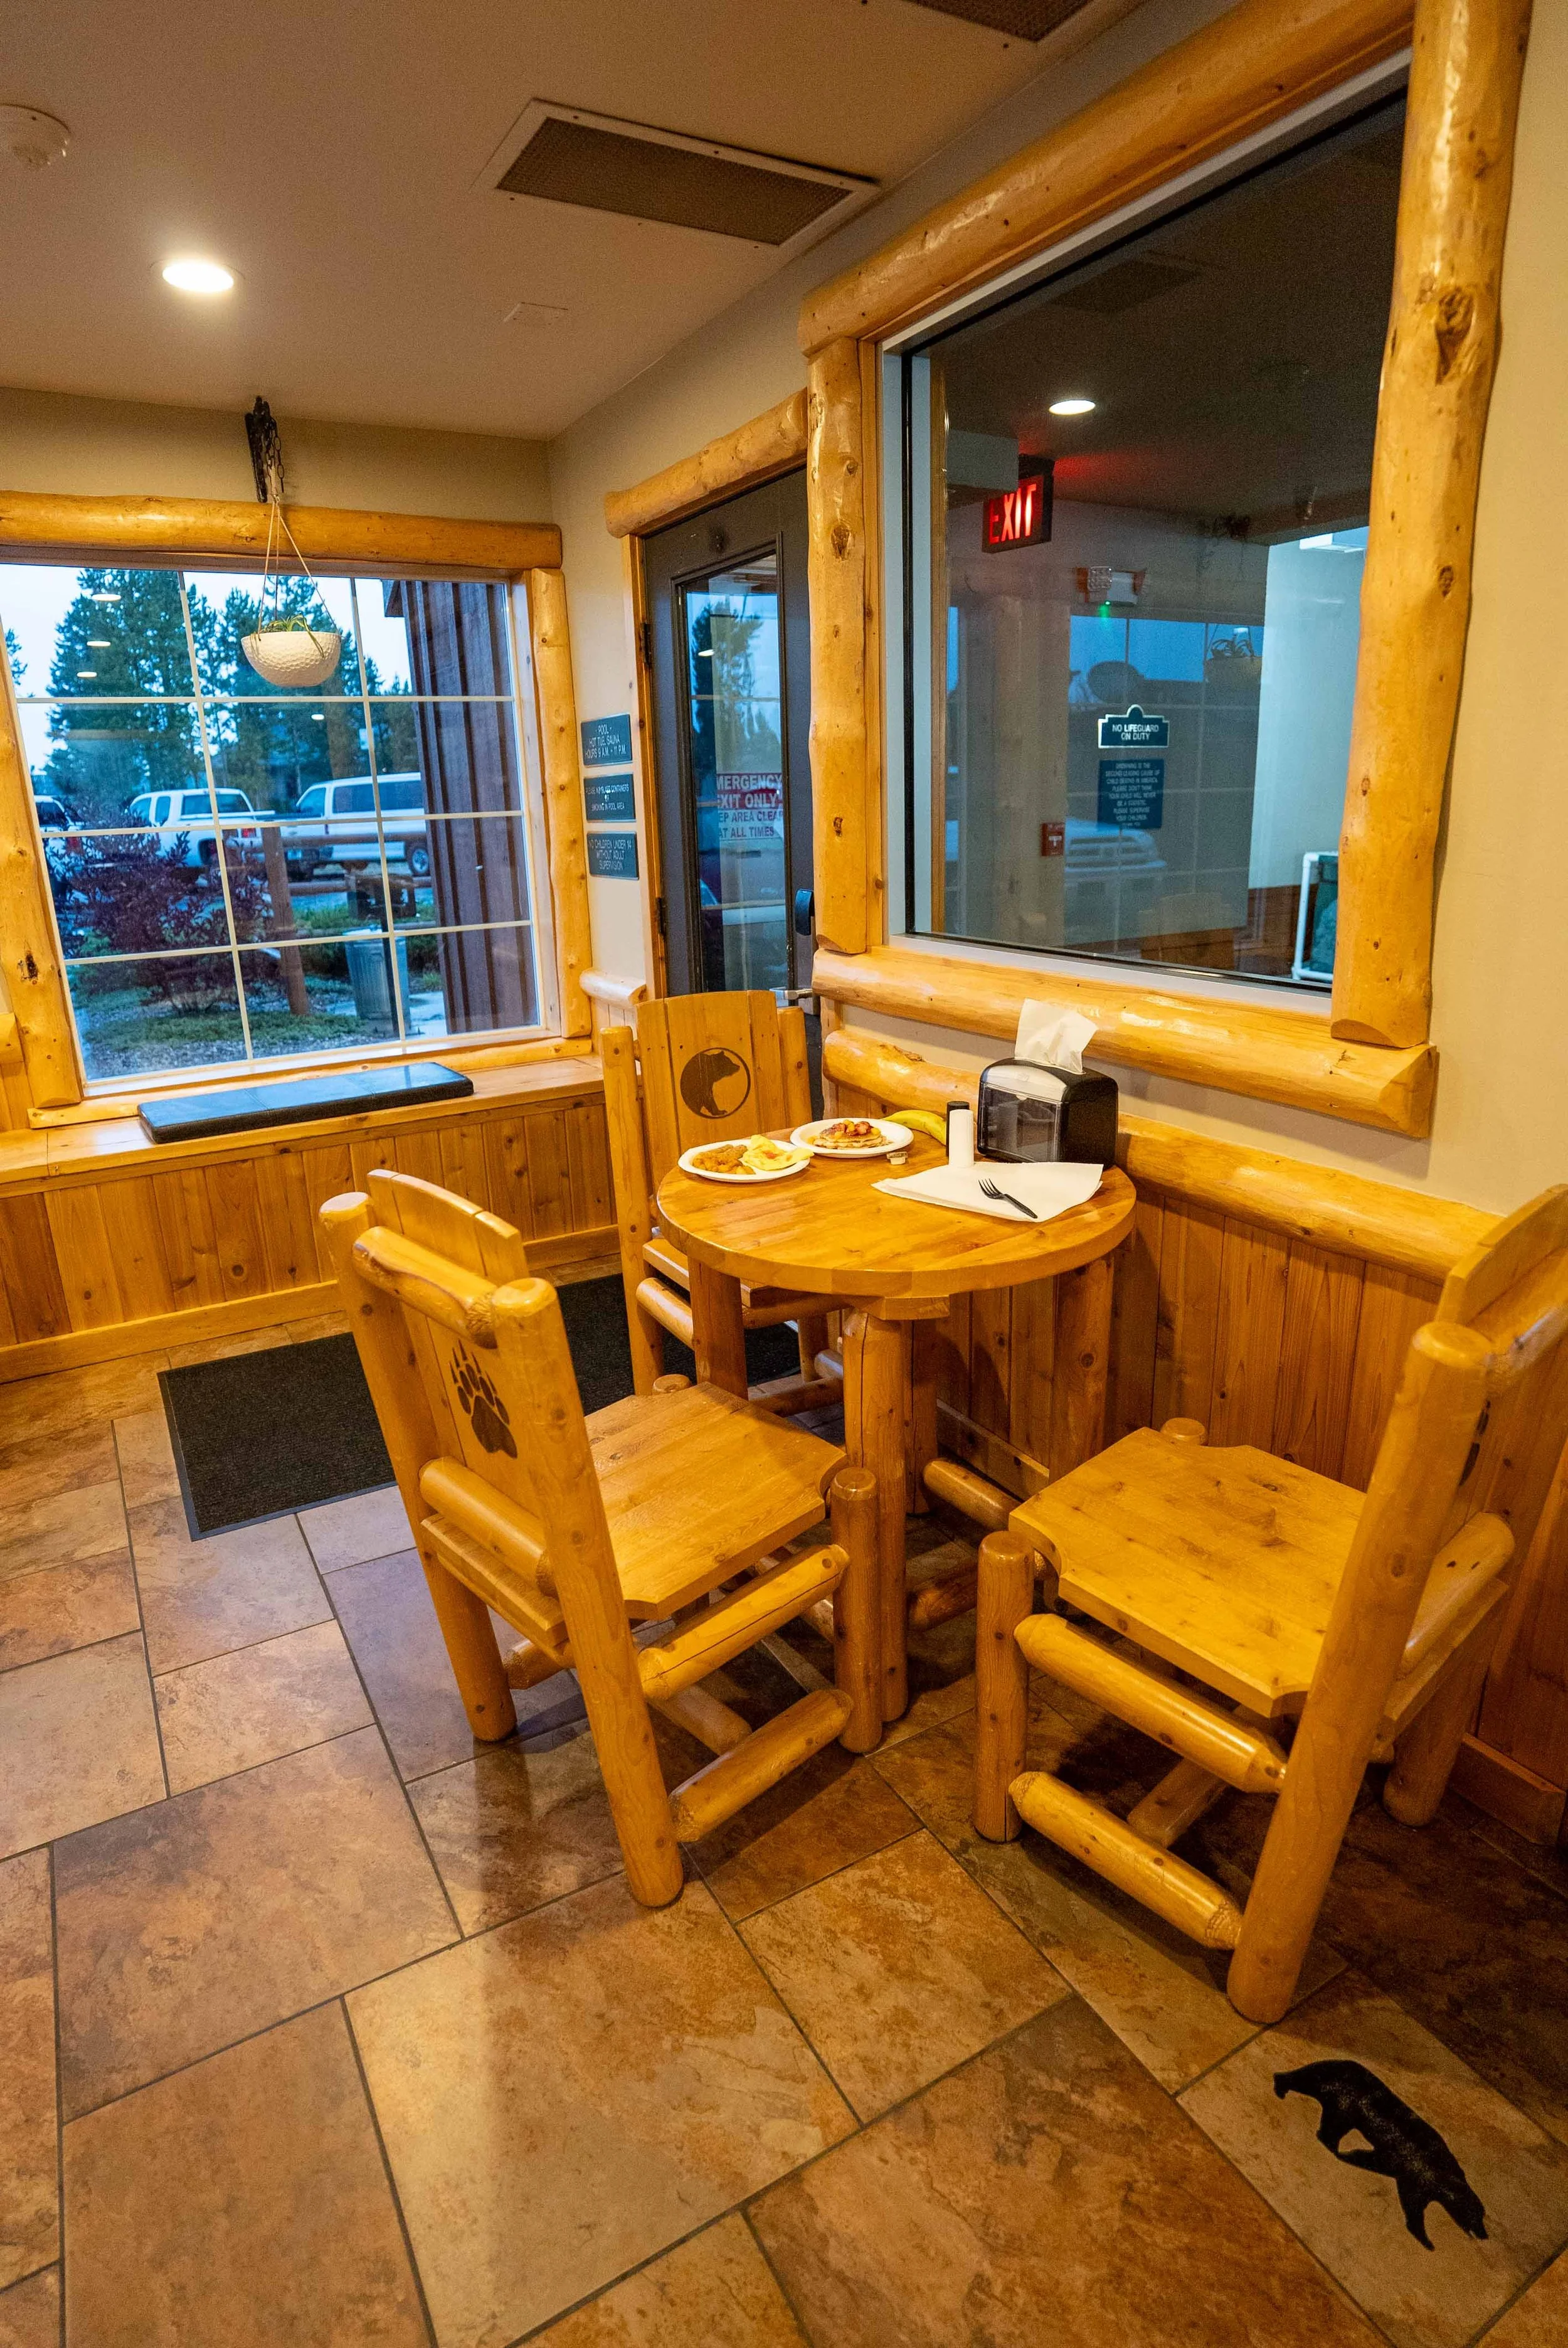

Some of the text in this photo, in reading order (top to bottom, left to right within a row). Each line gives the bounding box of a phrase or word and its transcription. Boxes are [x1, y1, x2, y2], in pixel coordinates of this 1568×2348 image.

[989, 483, 1037, 545] EXIT
[598, 724, 609, 735] POOL
[1112, 723, 1159, 732] NO LIFEGUARD
[607, 733, 620, 745] SAUNA
[1121, 732, 1150, 740] ON DUTY
[585, 747, 597, 758] HOURS
[598, 747, 601, 758] 9
[717, 775, 782, 790] MERGENCY
[744, 793, 776, 808] ONLY
[719, 812, 729, 822] EP
[733, 812, 755, 822] AREA
[731, 827, 746, 837] ALL
[749, 826, 774, 837] TIMES
[595, 839, 612, 849] CHILDREN
[612, 839, 626, 849] UNDER
[596, 849, 624, 860] WITHOUT ADULT
[599, 860, 623, 871] SUPERVISION
